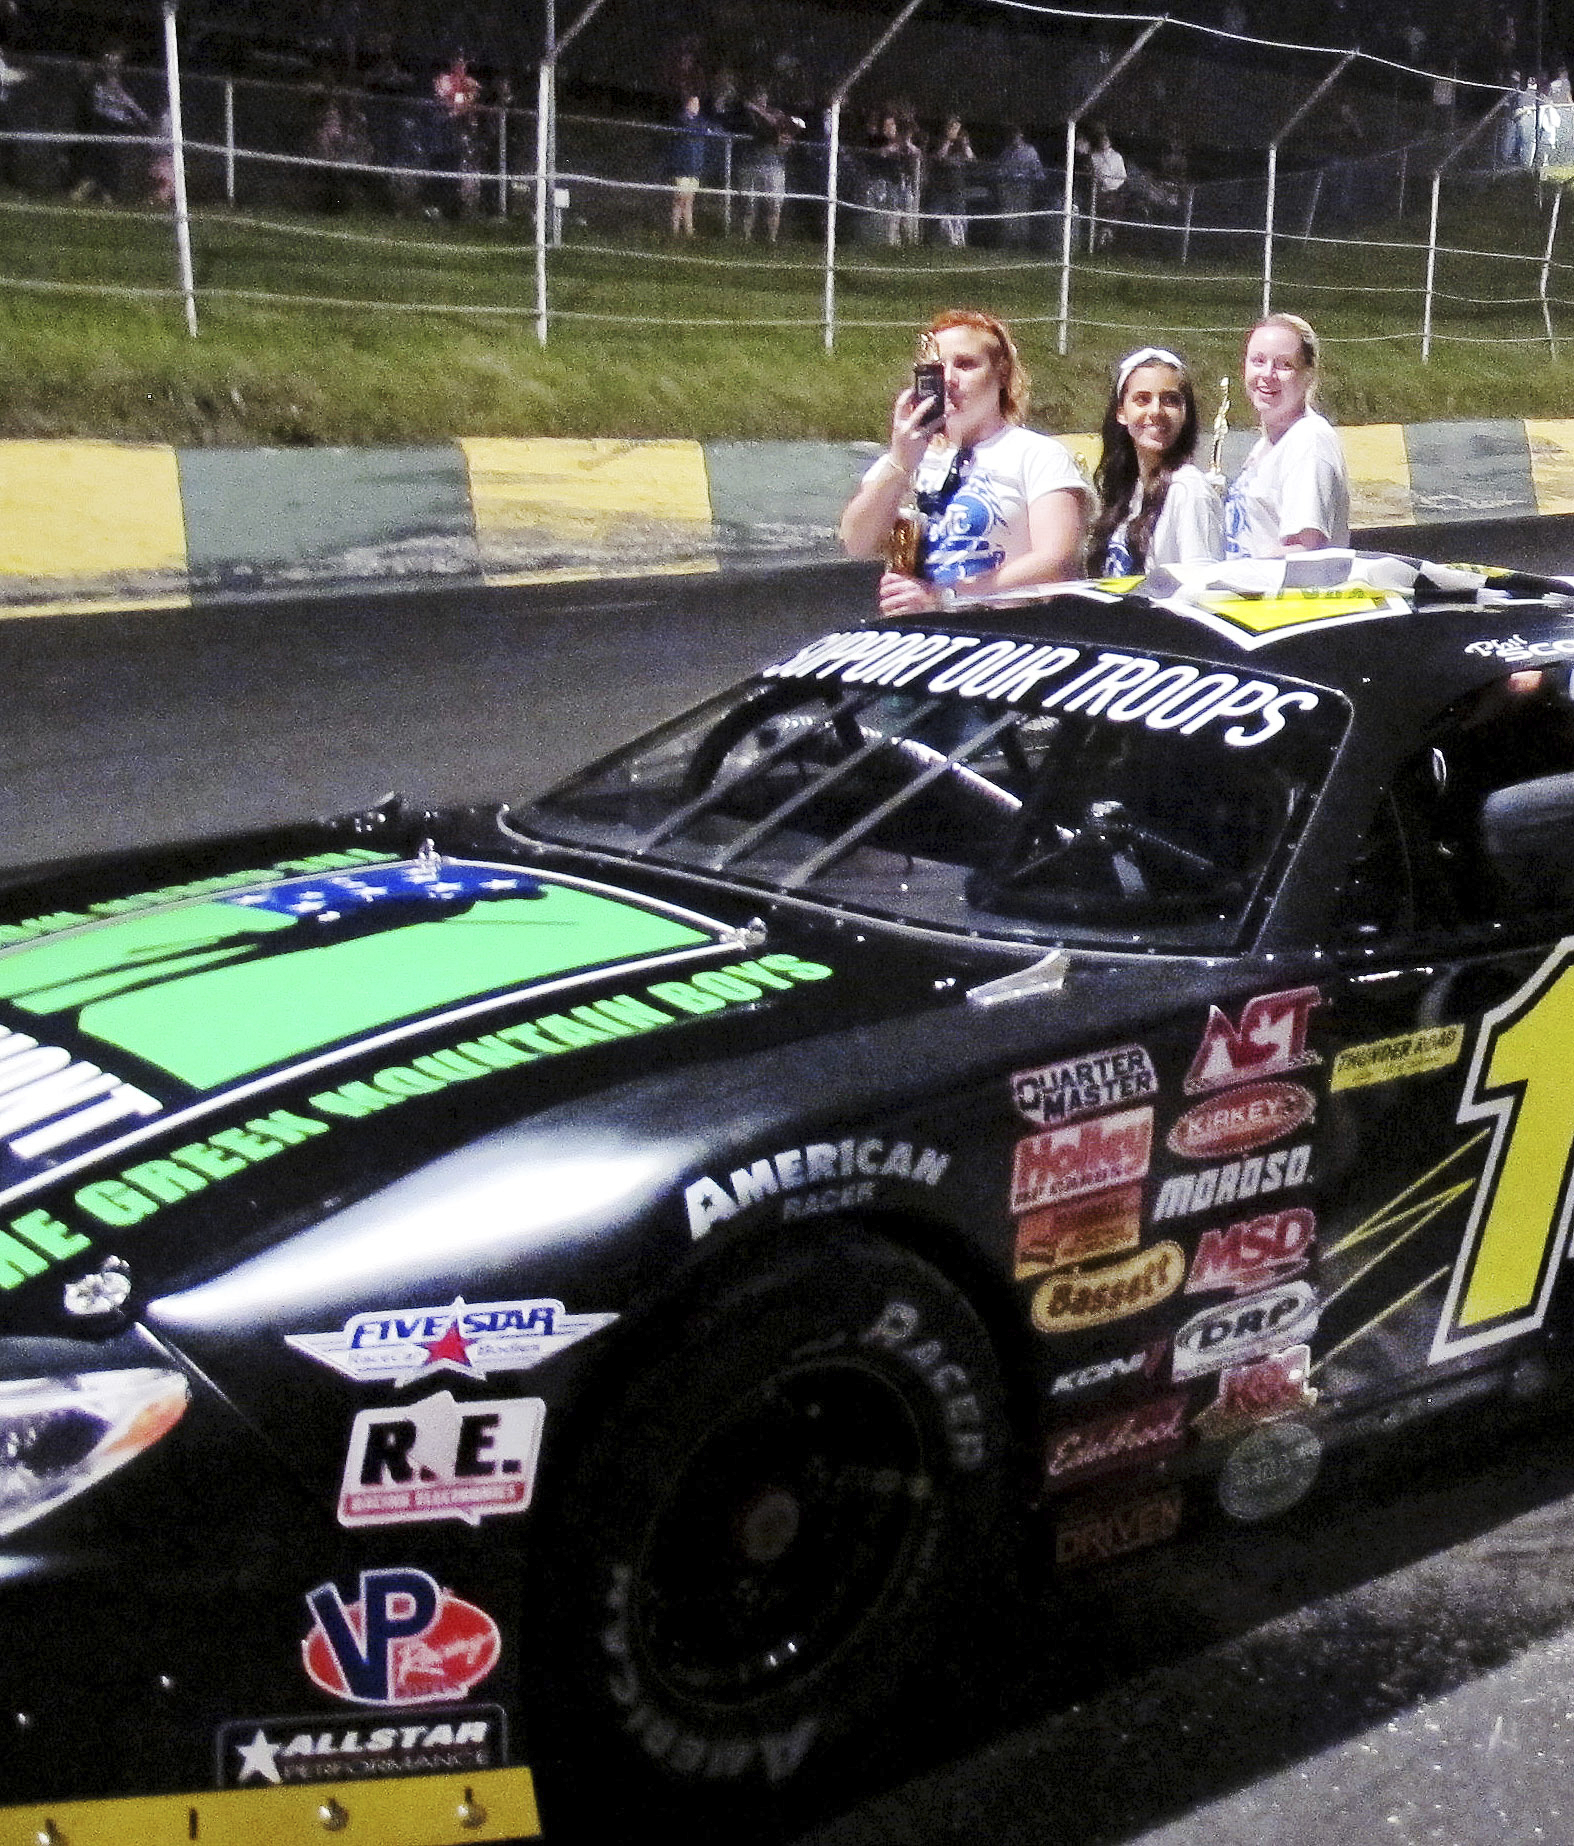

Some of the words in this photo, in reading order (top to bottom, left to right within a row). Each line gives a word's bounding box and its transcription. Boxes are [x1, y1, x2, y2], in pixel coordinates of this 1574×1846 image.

[762, 630, 981, 688] SUPPORT
[928, 640, 1081, 702] OUR
[1041, 651, 1320, 749] TROOPS
[1183, 985, 1323, 1097] ACT
[74, 1108, 330, 1227] GREEN
[308, 994, 675, 1118] MOUNTAIN
[647, 953, 834, 1015] BOYS
[1015, 1049, 1147, 1111] QUARTER
[1044, 1069, 1153, 1122] MASTER
[684, 1137, 951, 1242] AMERICAN
[1153, 1144, 1313, 1222] MOROSO
[1192, 1207, 1317, 1278] MSD
[1048, 1252, 1173, 1319] Bassett
[351, 1315, 452, 1350] FIVE
[462, 1306, 553, 1336] STAR
[1199, 1296, 1301, 1350] DRP
[1056, 1497, 1184, 1562] DRIVEN
[305, 1567, 444, 1704] VP
[280, 1720, 489, 1758] ALLSTAR
